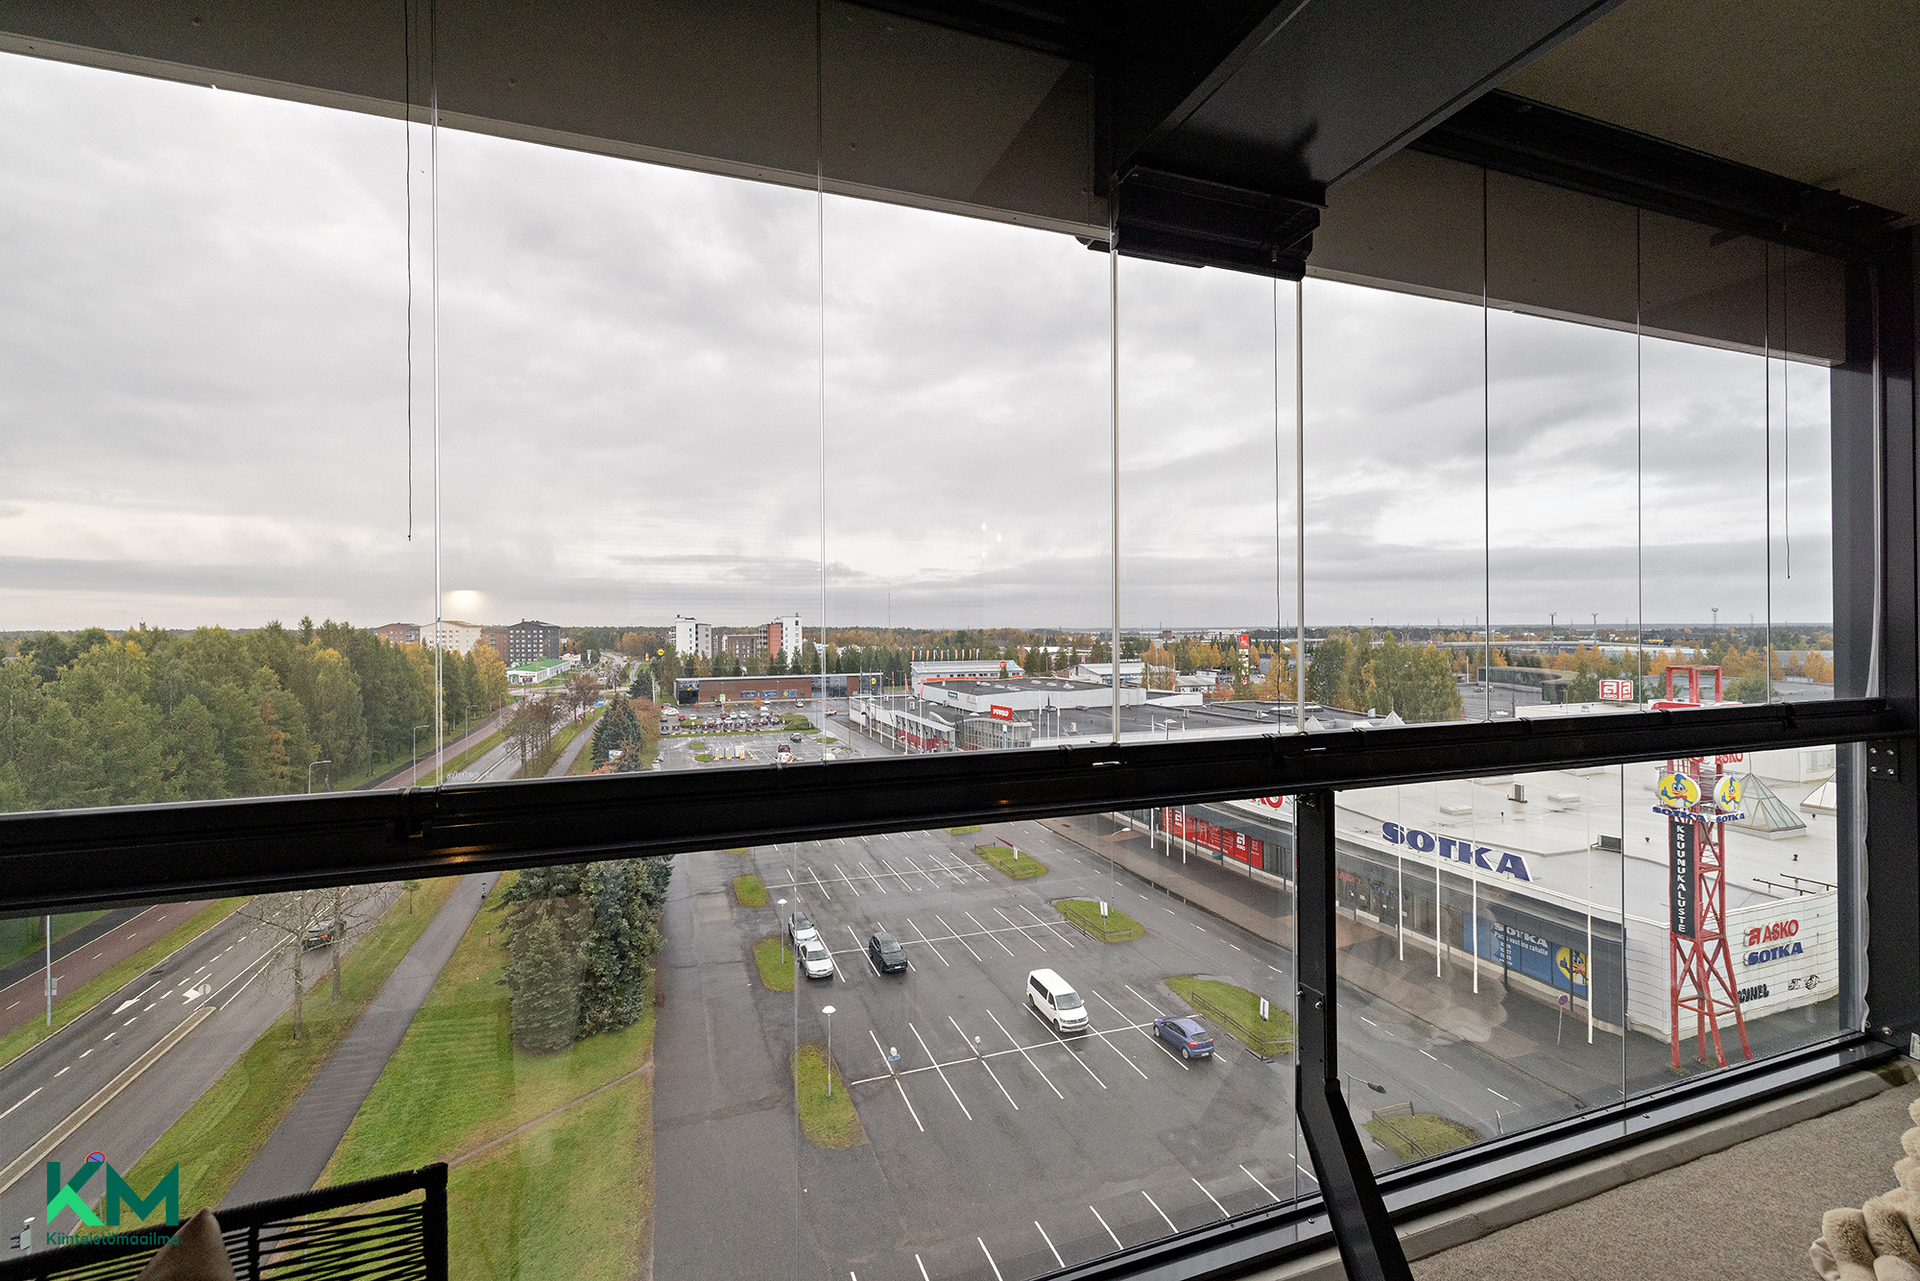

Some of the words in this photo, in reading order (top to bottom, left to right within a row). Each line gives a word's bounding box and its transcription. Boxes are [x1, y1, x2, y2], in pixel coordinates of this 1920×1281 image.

[1652, 806, 1706, 822] SOTKA
[1716, 813, 1745, 823] SOTKA
[1381, 821, 1532, 882] SOTKA
[1676, 825, 1686, 932] KRUUNUKALUSTE
[1494, 923, 1549, 948] SOTKA
[1762, 919, 1799, 943] ASKO
[1748, 942, 1804, 966] SOTKA
